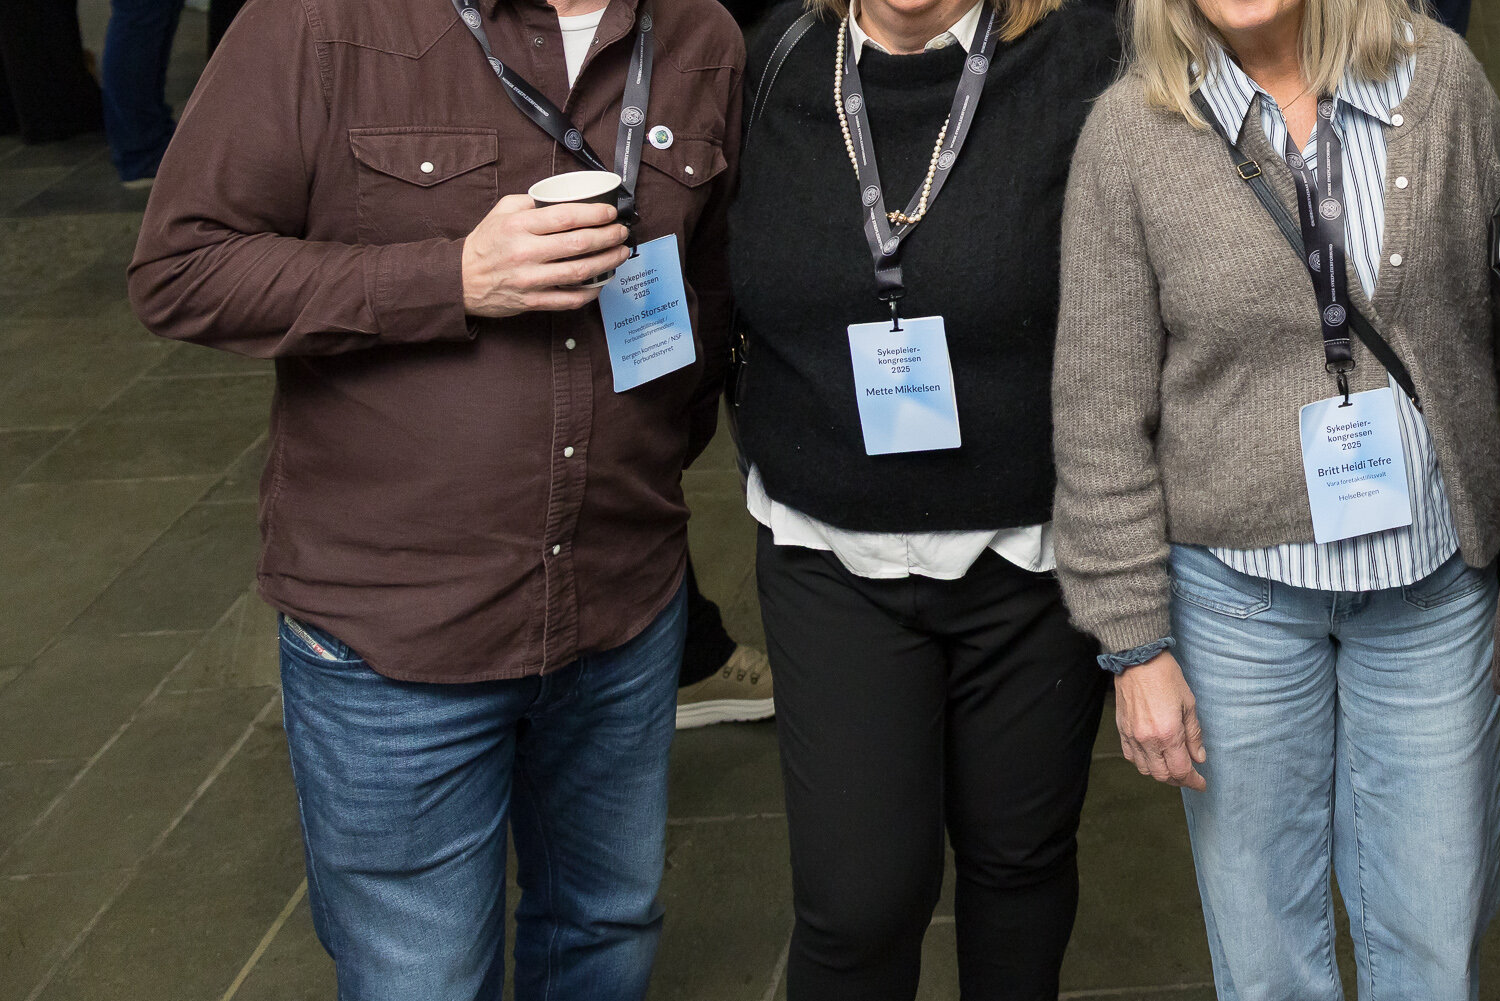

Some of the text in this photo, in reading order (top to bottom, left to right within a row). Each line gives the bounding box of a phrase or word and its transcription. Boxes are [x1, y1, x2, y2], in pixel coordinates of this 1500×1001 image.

[620, 268, 657, 286] Sykepleier-
[621, 276, 659, 294] kongressen
[633, 288, 651, 300] 2025
[613, 299, 680, 330] Jostein Storsæter
[621, 349, 642, 362] Bergen
[641, 340, 668, 353] kommune
[633, 345, 674, 366] Forbundsstyret
[877, 346, 920, 356] Sykepleier-
[878, 356, 921, 365] kongressen
[891, 365, 910, 374] 2025
[866, 383, 941, 396] Mette Mikkelsen
[1326, 420, 1371, 433] Sykepleier-
[1327, 429, 1372, 442] kongressen
[1341, 440, 1362, 451] 2025
[1317, 457, 1392, 477] Britt Heidi Tefre
